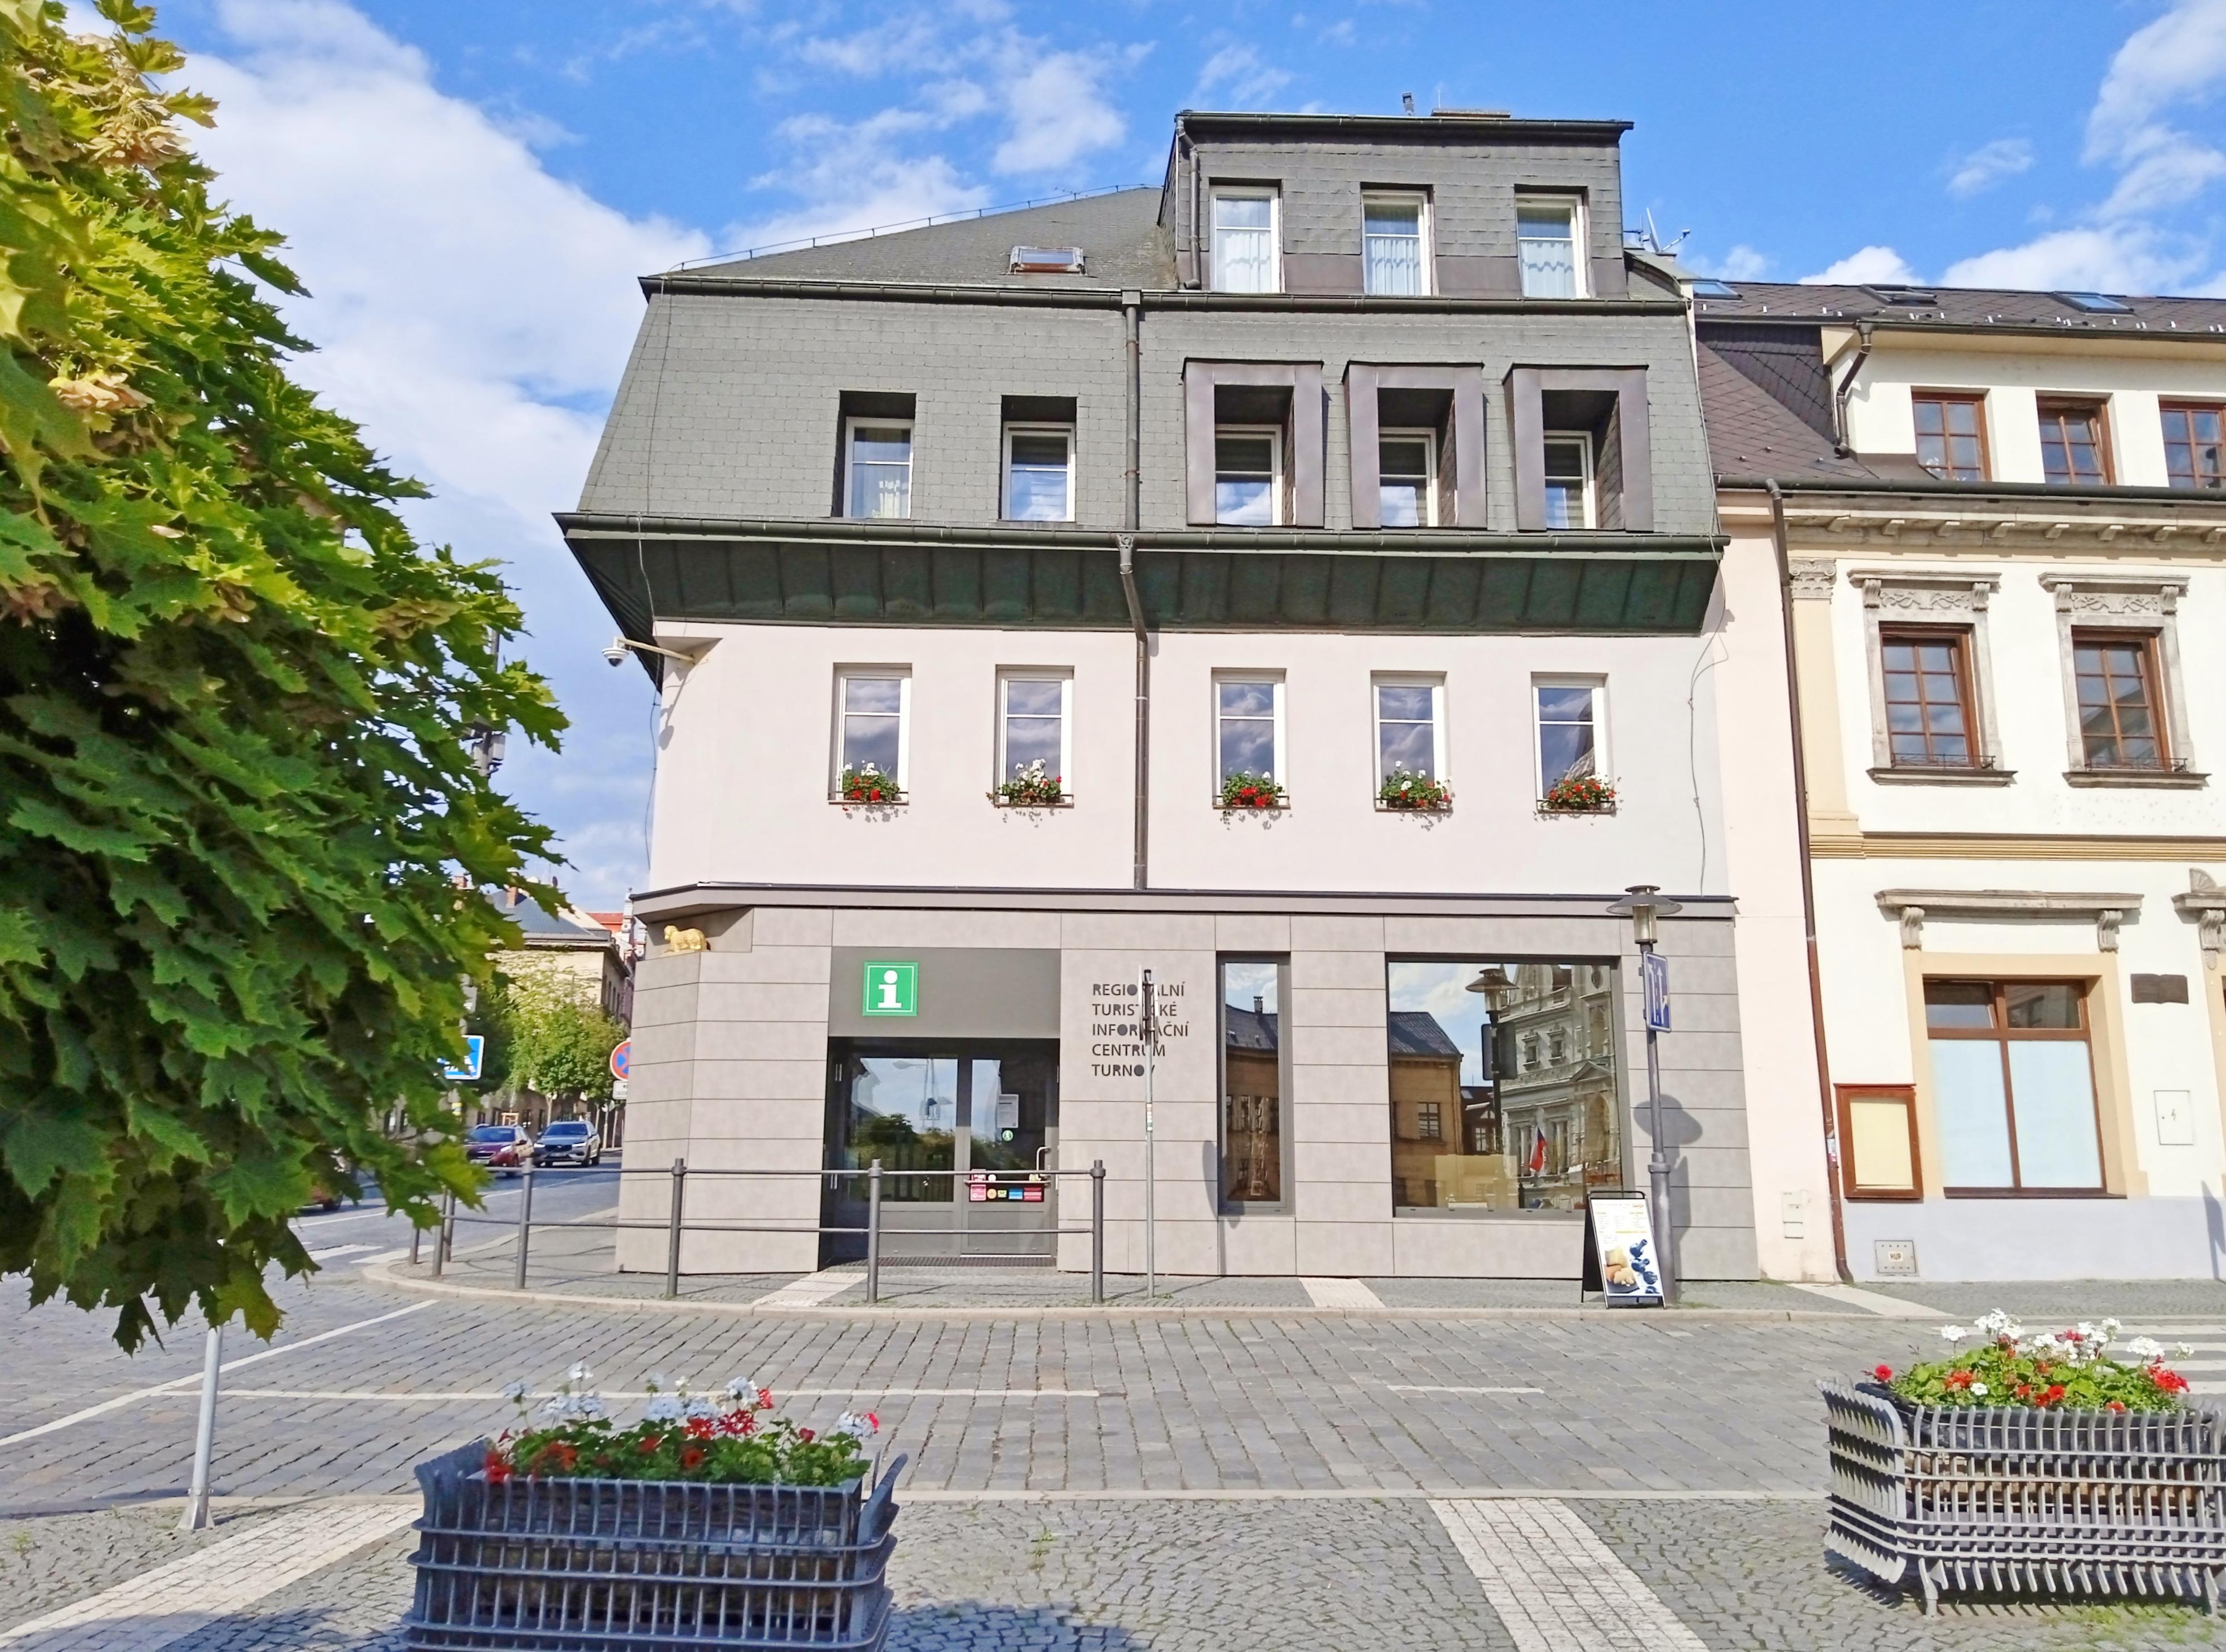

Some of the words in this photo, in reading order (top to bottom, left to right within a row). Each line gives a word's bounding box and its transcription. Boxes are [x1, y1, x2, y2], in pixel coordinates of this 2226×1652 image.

[1092, 982, 1185, 996] REGIOLNÍ
[1092, 1002, 1177, 1017] TURISKÉ
[1092, 1021, 1189, 1037] INFORČNÍ
